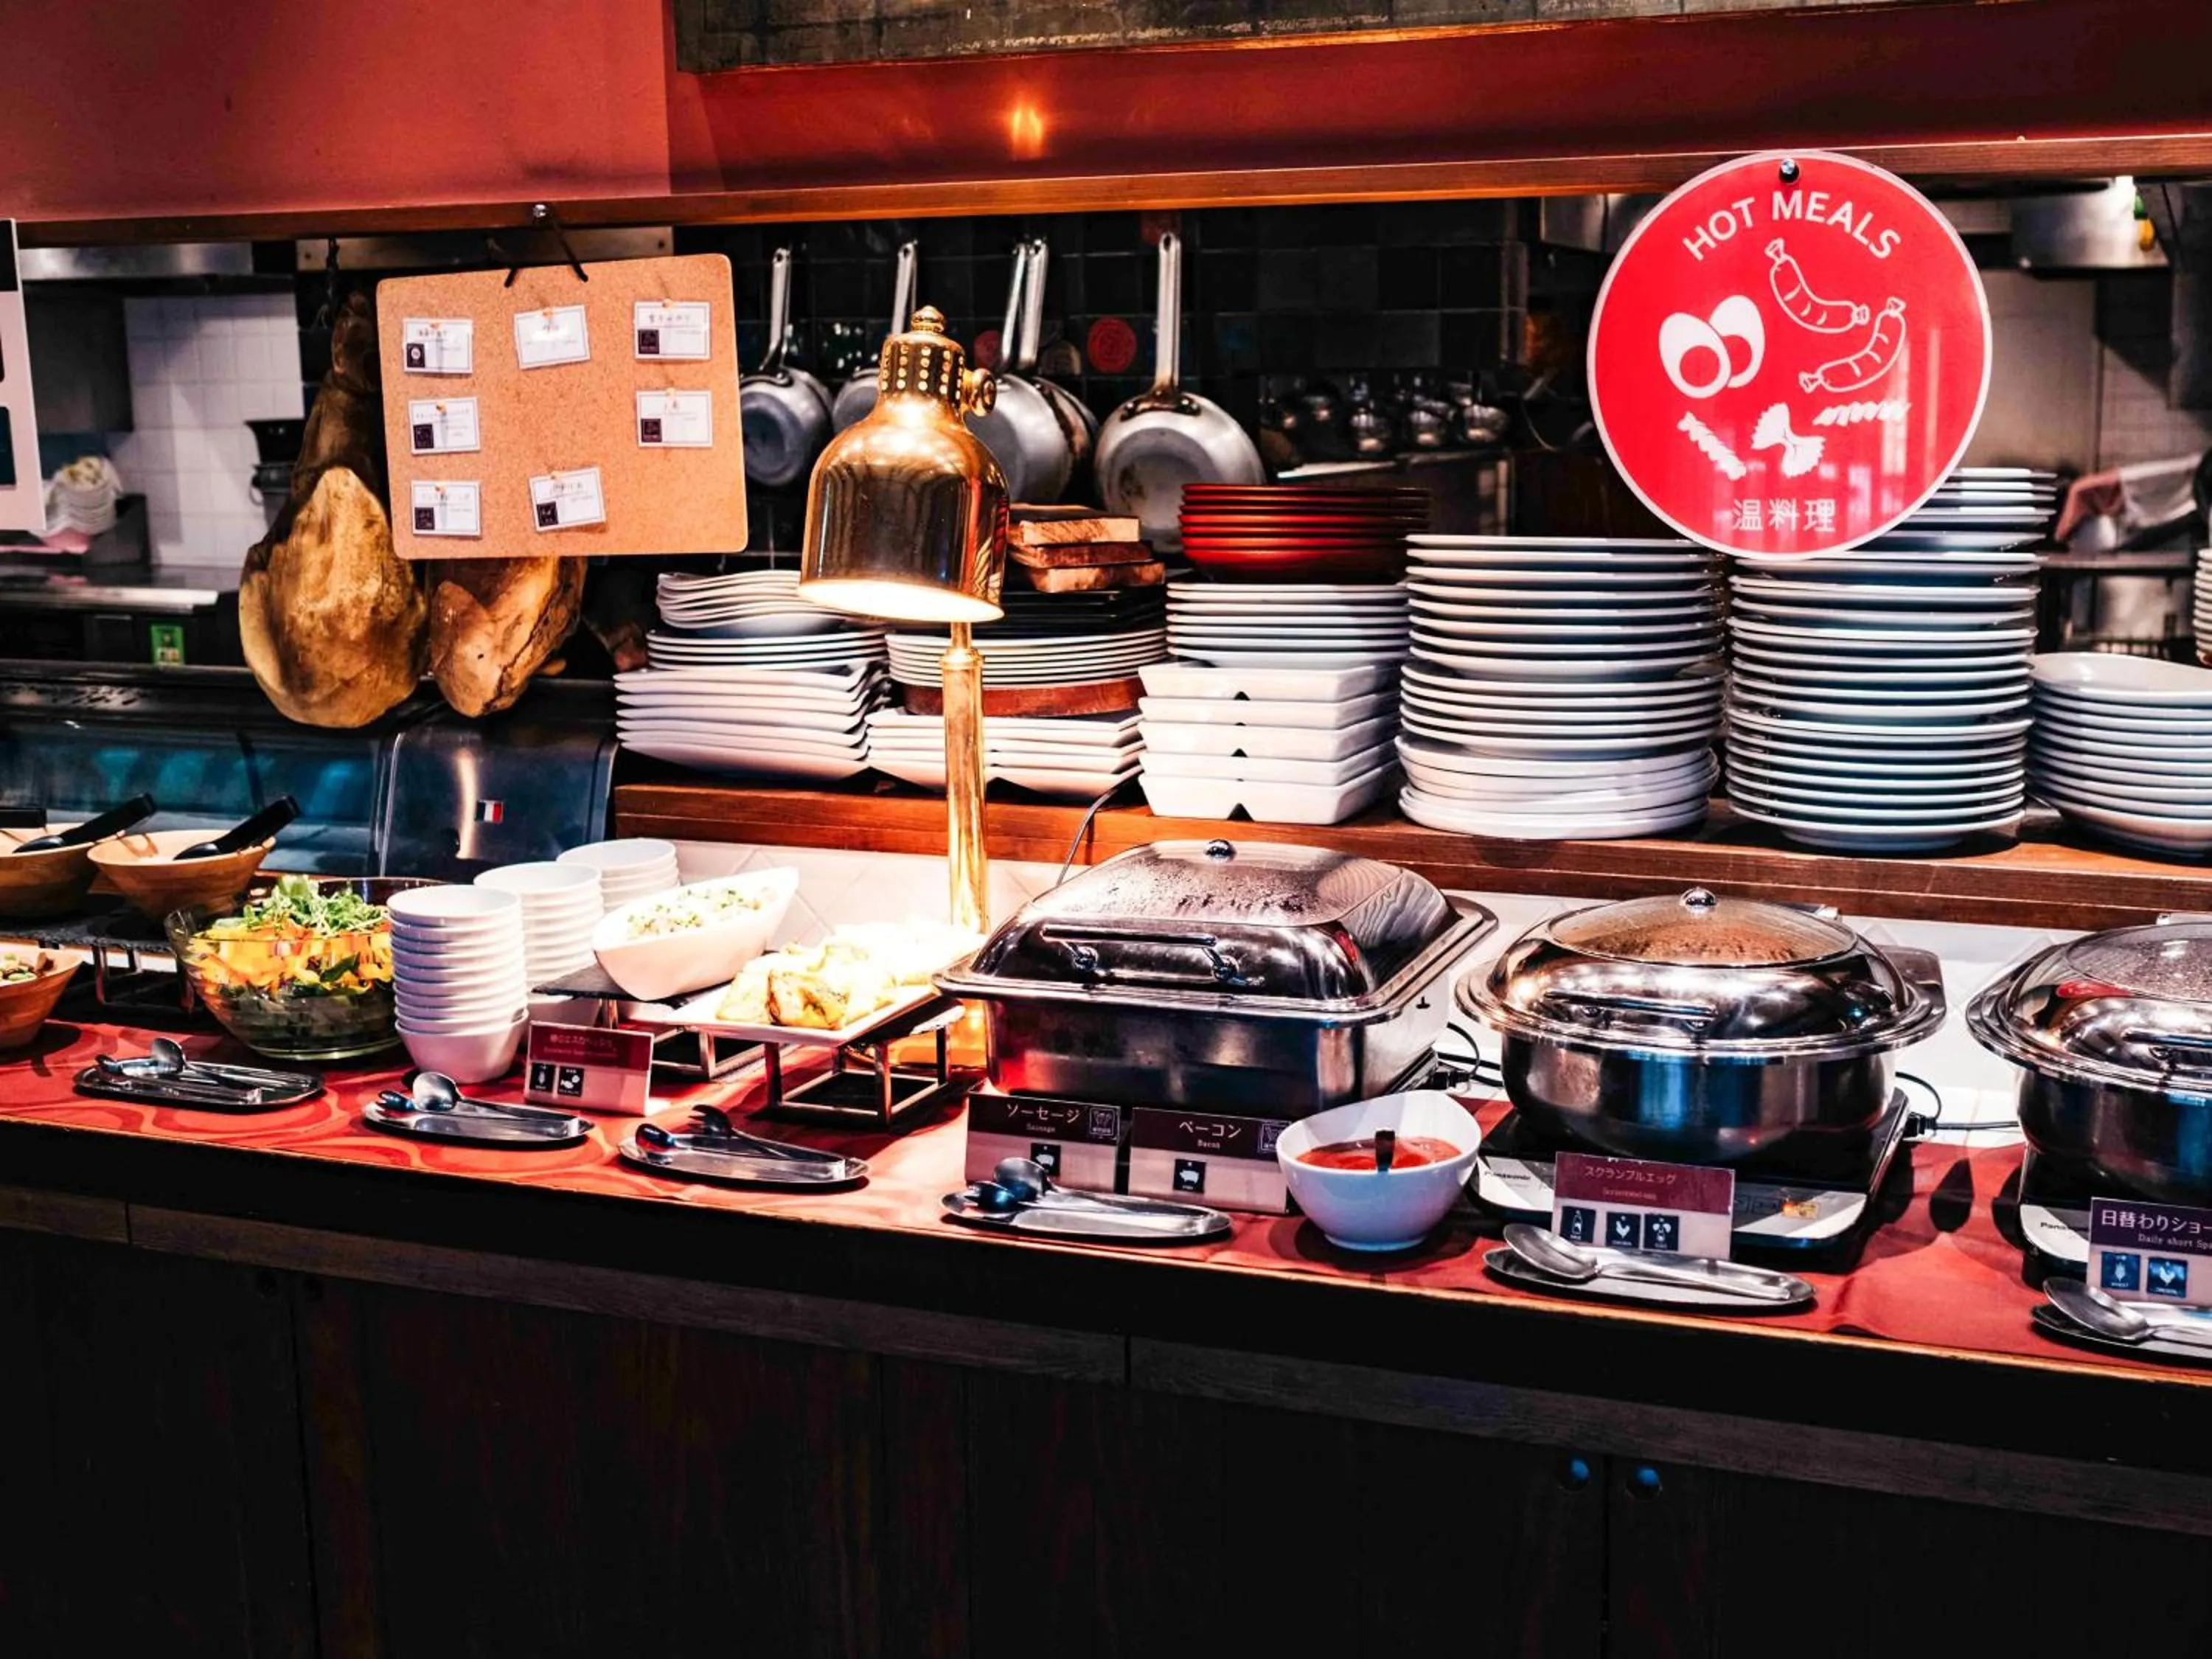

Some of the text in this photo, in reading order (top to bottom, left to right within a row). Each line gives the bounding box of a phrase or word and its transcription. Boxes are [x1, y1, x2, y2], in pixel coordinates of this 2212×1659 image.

[1682, 189, 1902, 261] HOT MEALS
[1732, 498, 1836, 532] 温料理
[1006, 1104, 1080, 1123] ソーセージ
[1179, 1121, 1242, 1138] ベーコン
